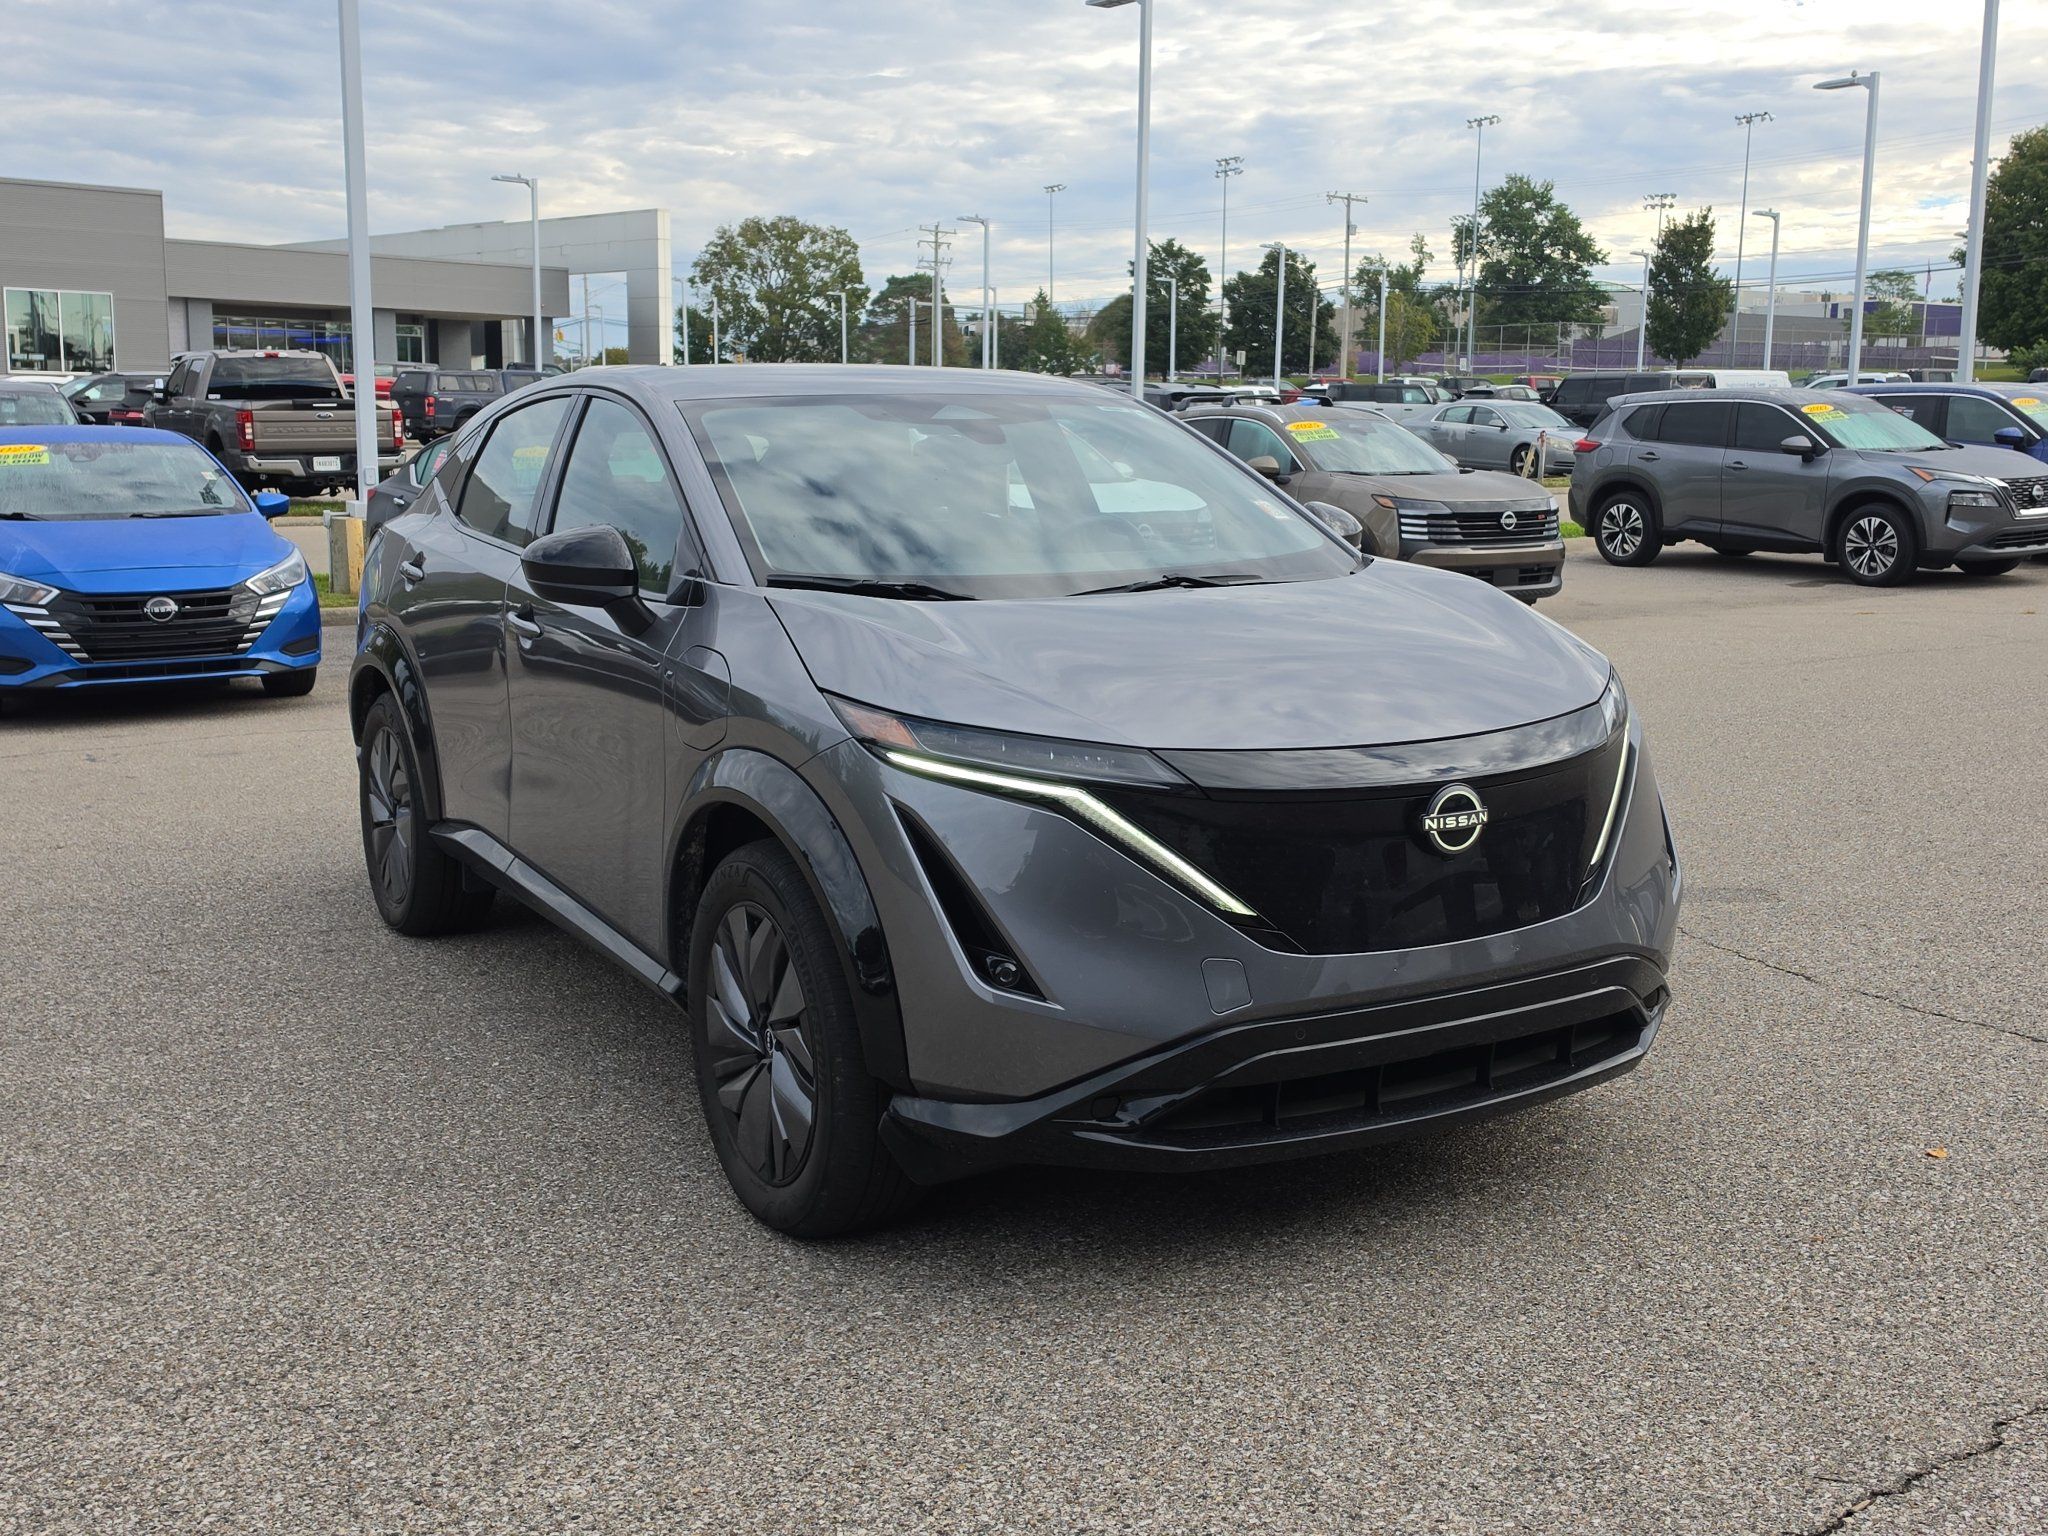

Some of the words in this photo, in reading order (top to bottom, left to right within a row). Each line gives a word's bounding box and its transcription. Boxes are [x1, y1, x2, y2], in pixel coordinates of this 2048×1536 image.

[12, 452, 44, 460] BELOW
[143, 604, 178, 613] NISSAN
[1424, 811, 1487, 830] NISSAN
